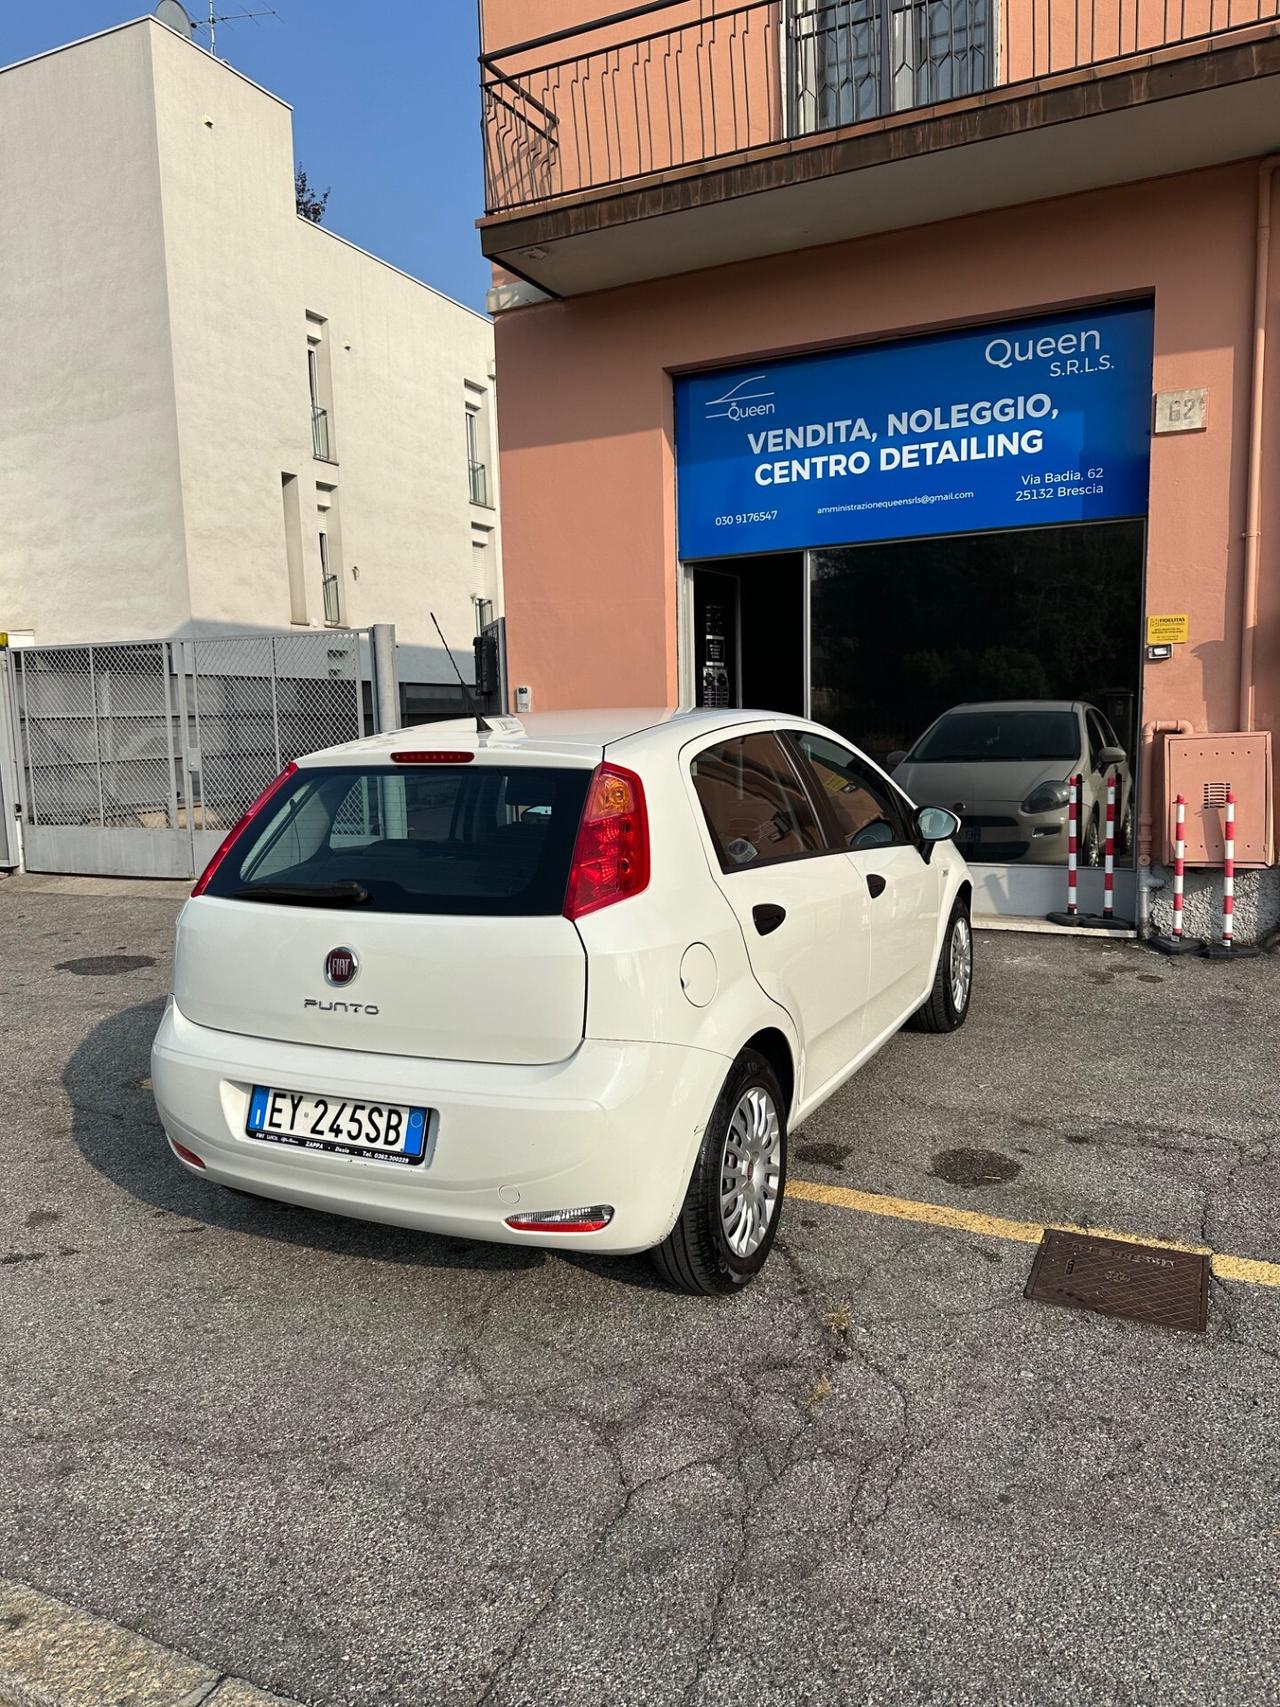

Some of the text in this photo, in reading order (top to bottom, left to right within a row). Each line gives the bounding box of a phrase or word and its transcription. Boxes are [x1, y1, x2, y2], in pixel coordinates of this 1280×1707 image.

[985, 329, 1101, 369] Queen
[1049, 355, 1115, 377] S.R.L.S.
[728, 402, 775, 421] Queen
[747, 393, 1059, 455] VENDITA, NOLEGGIO,
[754, 429, 1043, 486] CENTRO DETAILING
[1021, 467, 1104, 485] Via Badia, 62
[817, 490, 974, 514] amministrazionequeensrls@gmail.com
[1015, 483, 1104, 502] 25132 Brescia
[715, 510, 777, 526] 030 9176547
[331, 958, 351, 976] FIAT
[304, 999, 379, 1016] PUNTO
[268, 1092, 403, 1146] EY 245SB
[305, 1141, 324, 1150] ZAPPA
